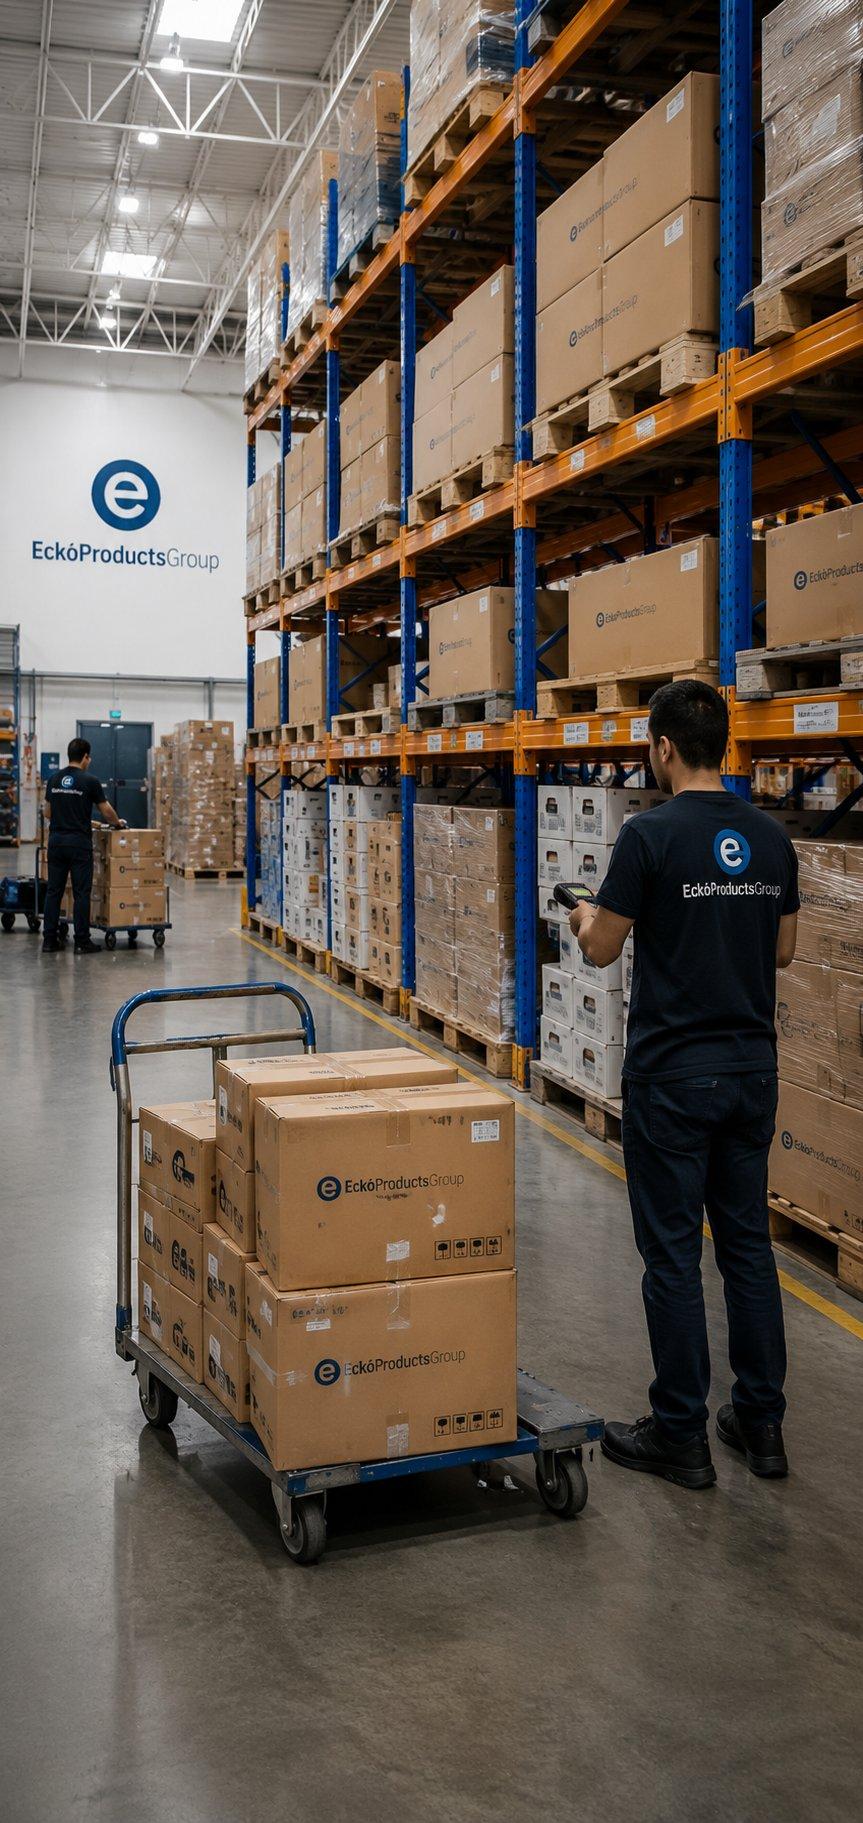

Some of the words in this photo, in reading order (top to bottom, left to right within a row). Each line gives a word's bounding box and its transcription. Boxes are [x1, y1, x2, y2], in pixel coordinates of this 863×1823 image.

[32, 540, 219, 573] EckóProductsGroup
[682, 881, 781, 899] EckóProductsGroup
[344, 1173, 465, 1193] EckóProductsGroup
[344, 1350, 466, 1376] EckóProductsGroup
